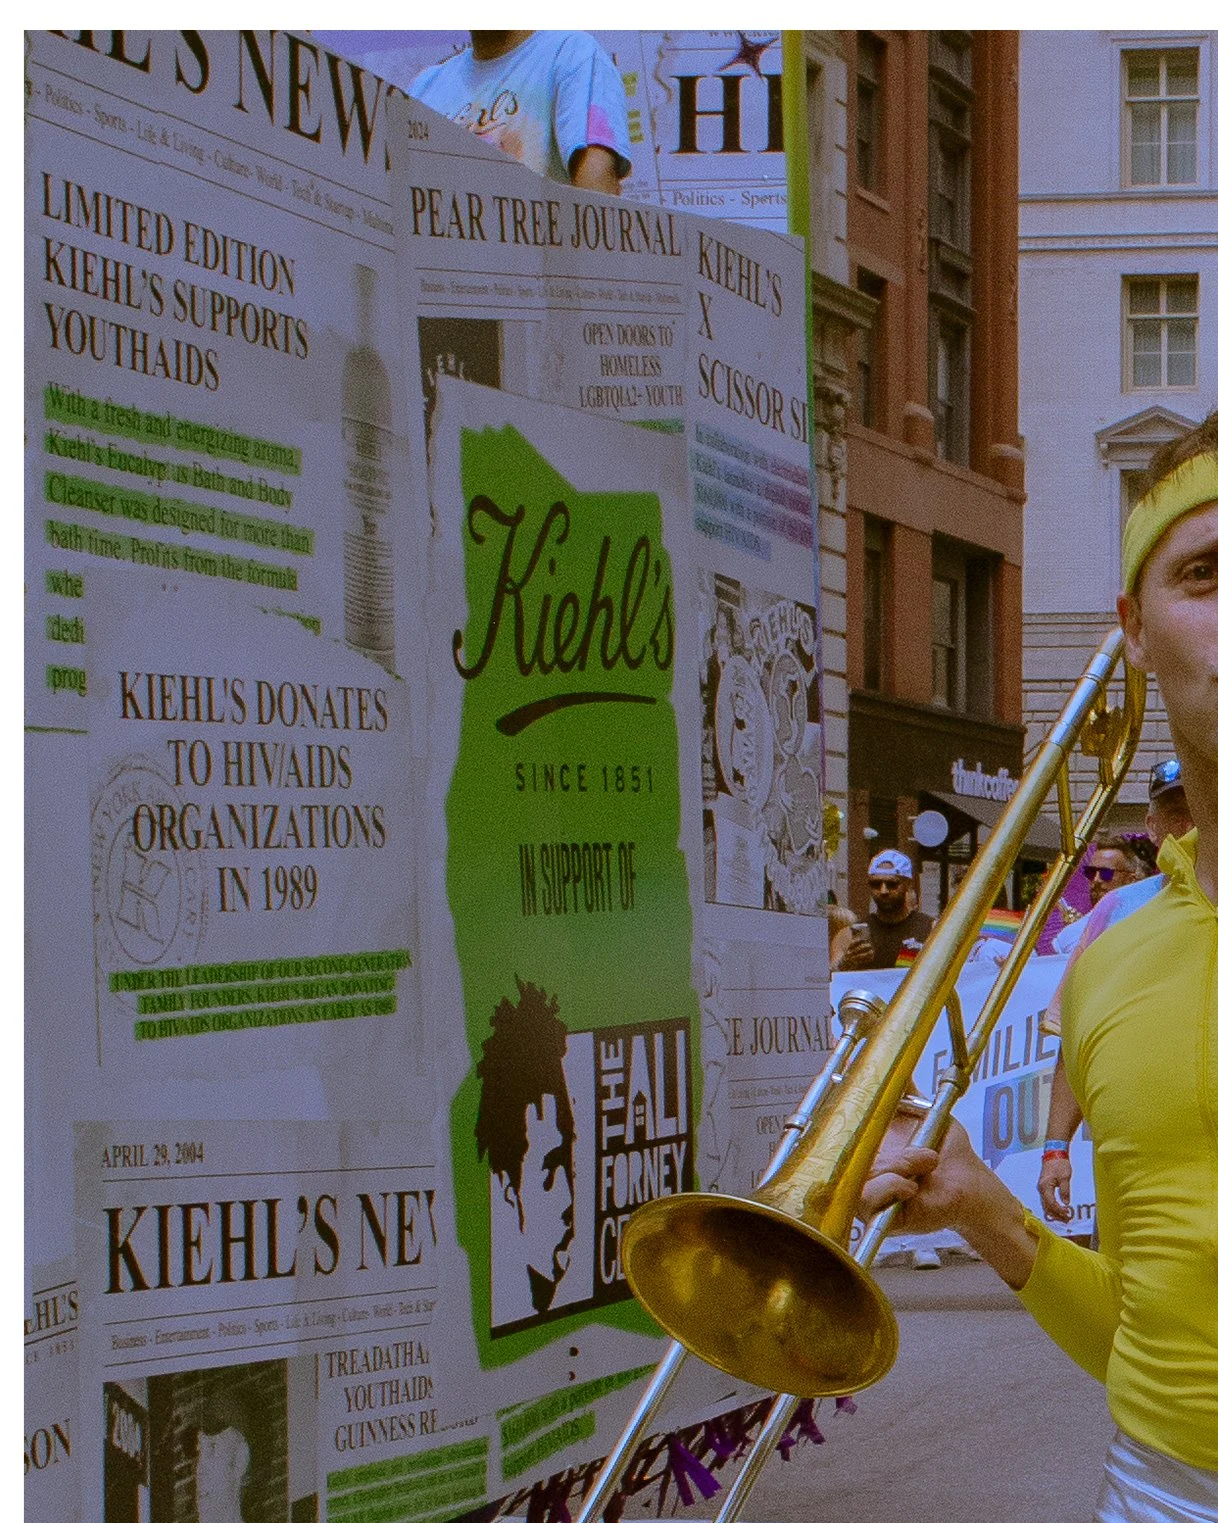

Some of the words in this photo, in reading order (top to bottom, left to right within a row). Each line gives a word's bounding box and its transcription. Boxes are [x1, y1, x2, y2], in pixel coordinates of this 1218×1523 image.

[95, 102, 128, 134] Sports
[41, 171, 175, 257] LIMITED
[183, 219, 296, 298] EDITION
[410, 186, 486, 243] PEAR
[493, 196, 563, 248] TREE
[571, 203, 683, 257] JOURNAL
[672, 192, 725, 208] Politics
[740, 190, 788, 210] Sports
[43, 236, 165, 318] KIEHL'S
[173, 278, 310, 361] SUPPORTS
[698, 230, 783, 318] KIEHL'S
[44, 303, 221, 392] YOUTHAIDS
[582, 322, 614, 346] OPEN
[617, 323, 656, 348] DOORS
[658, 325, 674, 348] TO
[698, 290, 713, 342] X
[600, 354, 662, 378] HOMELESS
[645, 384, 684, 408] YOUTH
[699, 352, 786, 435] SCISSOR
[47, 380, 86, 416] With
[103, 396, 141, 430] fresh
[145, 410, 171, 439] and
[176, 420, 250, 462] energizing
[48, 427, 102, 465] Kiehl's
[192, 461, 225, 492] Bath
[229, 474, 253, 499] and
[258, 477, 292, 513] Body
[48, 472, 115, 515] Cleanser
[120, 495, 148, 521] was
[152, 497, 215, 535] designed
[220, 509, 238, 539] for
[243, 522, 277, 547] more
[281, 524, 310, 553] than
[49, 518, 82, 552] bath
[130, 536, 178, 570] Profits
[183, 545, 217, 576] from
[221, 553, 242, 581] the
[452, 494, 674, 681] Kiehl's
[118, 671, 248, 725] KIEHL'S
[255, 680, 389, 732] DONATES
[167, 740, 213, 787] TO
[222, 741, 353, 789] HIV/AIDS
[515, 763, 588, 793] SINCE
[602, 764, 655, 793] 1851
[132, 803, 387, 852] ORGANIZATIONS
[218, 866, 251, 914] IN
[262, 864, 320, 913] 1989
[519, 842, 537, 917] IN
[540, 842, 614, 917] SUPPORT
[618, 841, 636, 913] OF
[727, 1017, 743, 1057] E
[750, 1015, 834, 1057] JOURNAL
[932, 1008, 1057, 1095] FMILIE
[601, 1037, 625, 1151] THE
[624, 1029, 688, 1146] ALI
[101, 1143, 148, 1168] APRIL
[153, 1144, 172, 1168] 29,
[174, 1141, 206, 1166] 2004
[602, 1140, 688, 1212] FORNEY
[103, 1194, 341, 1295] KIEHL'S
[335, 1412, 416, 1453] GUINNESS
